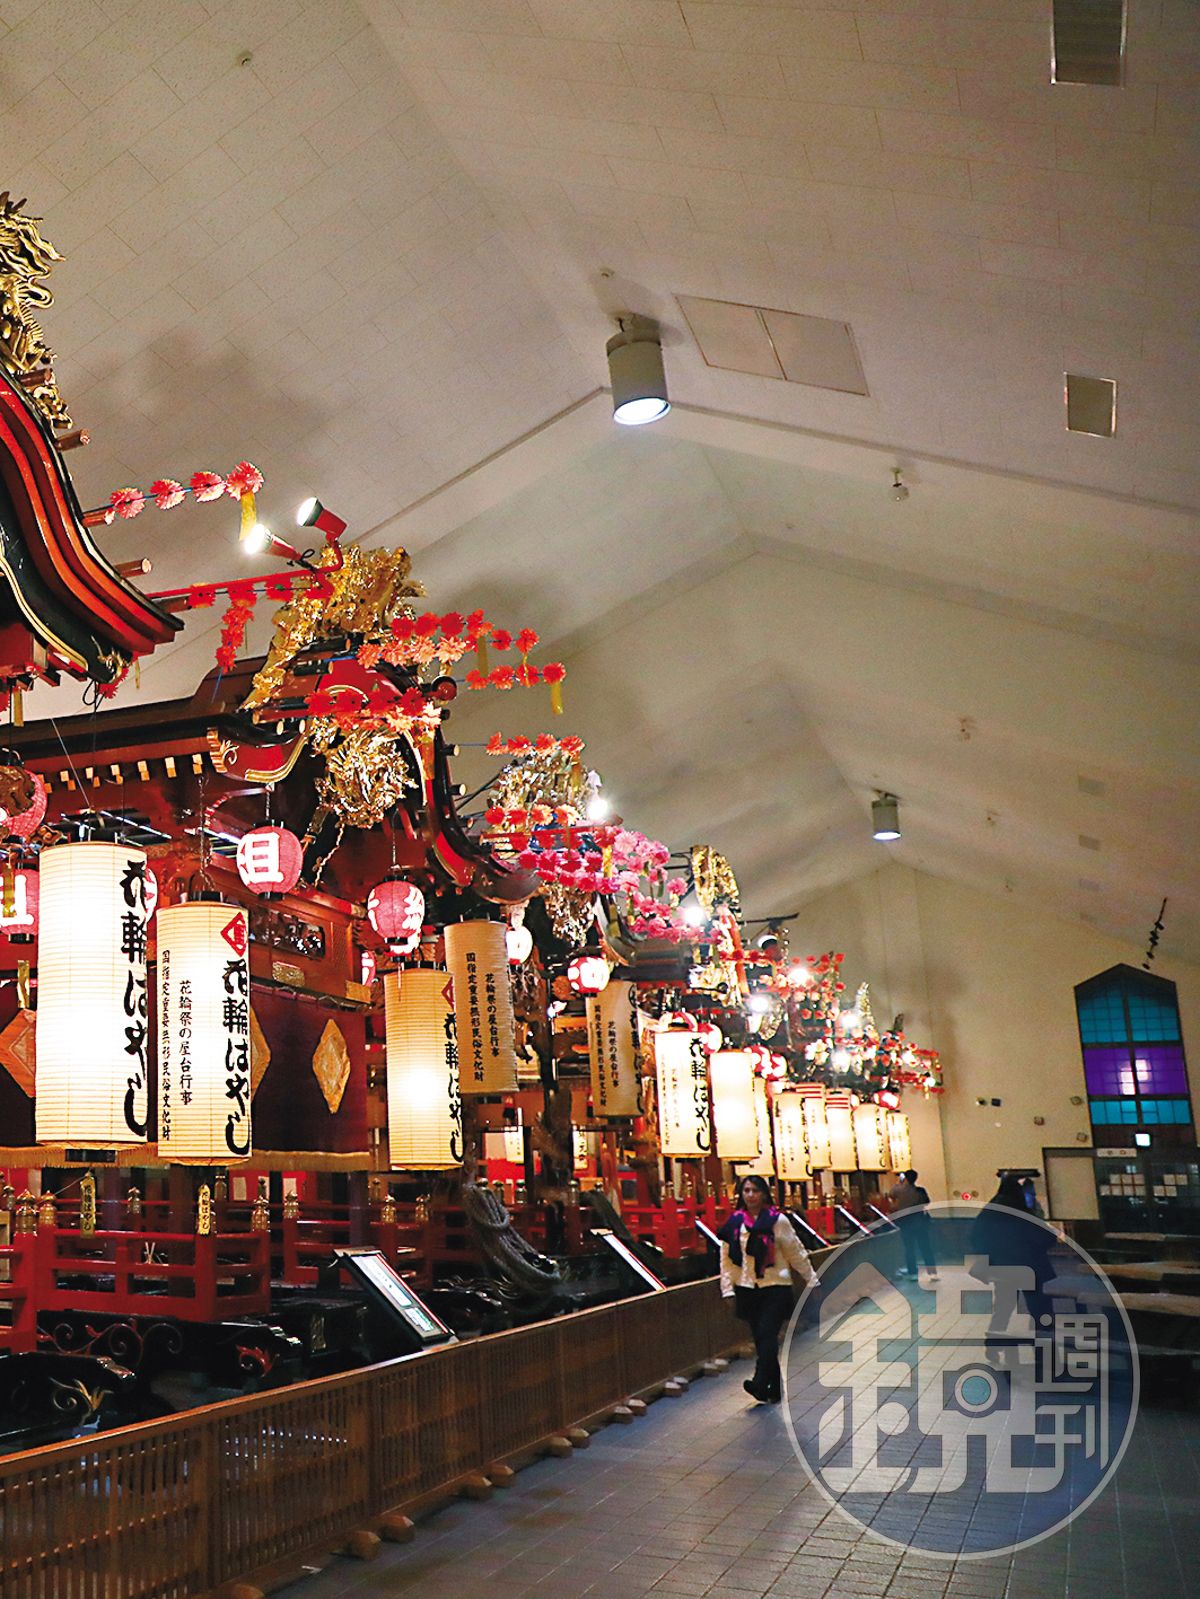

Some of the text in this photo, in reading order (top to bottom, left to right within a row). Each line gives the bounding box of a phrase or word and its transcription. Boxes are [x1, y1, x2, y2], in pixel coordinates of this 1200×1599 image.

[178, 980, 192, 1106] 花輪祭の屋台行事
